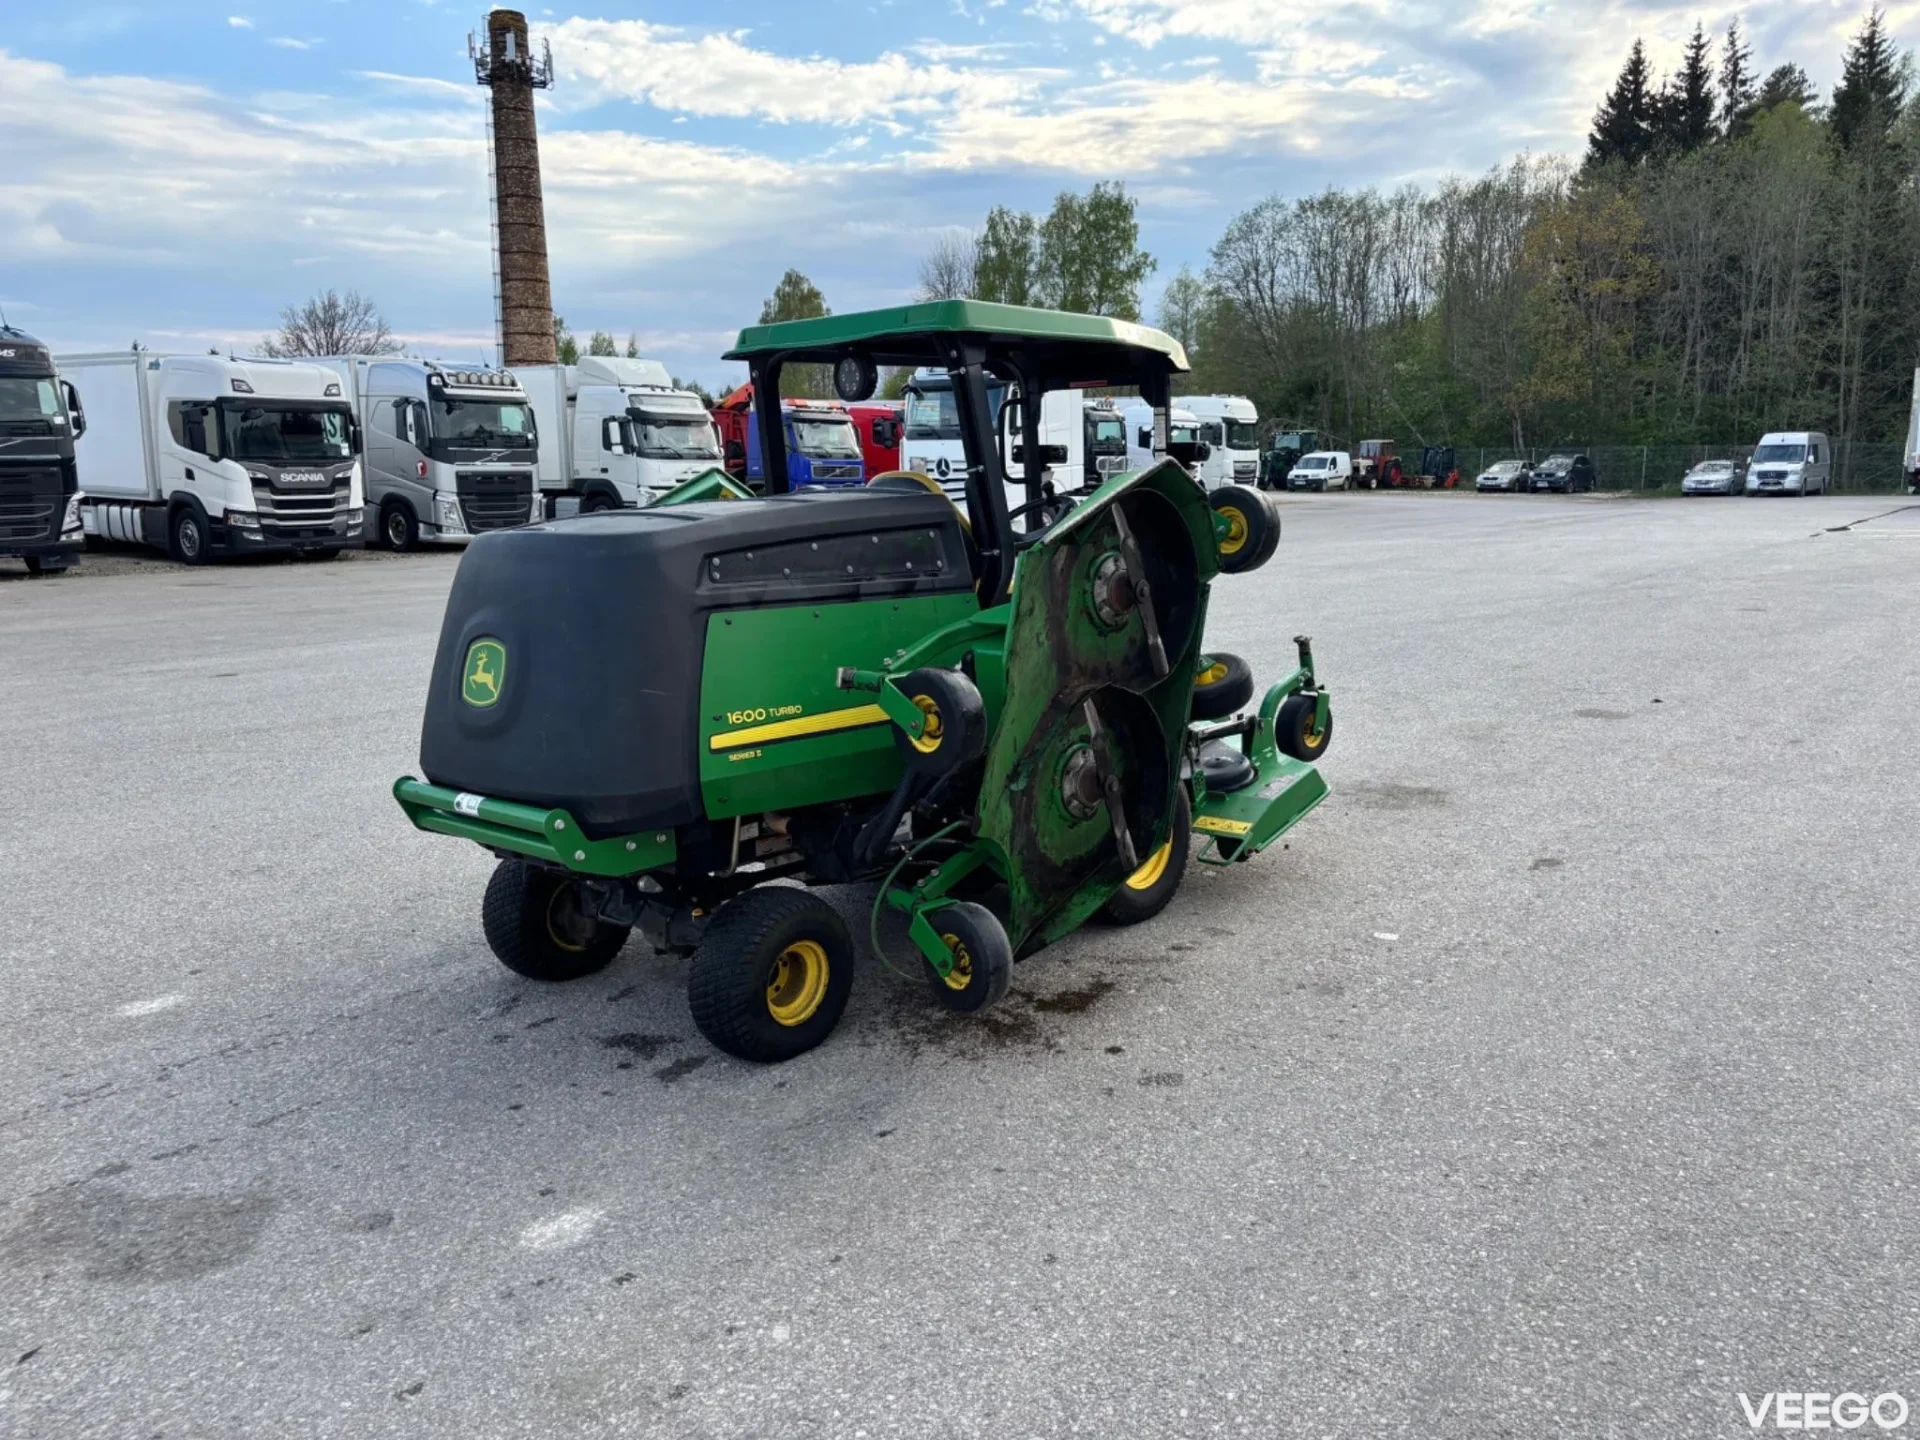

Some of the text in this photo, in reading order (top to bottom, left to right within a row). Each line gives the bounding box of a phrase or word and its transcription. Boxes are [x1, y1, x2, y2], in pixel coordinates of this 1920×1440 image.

[280, 472, 325, 482] SCANIA
[727, 705, 802, 725] 1600 TURBO
